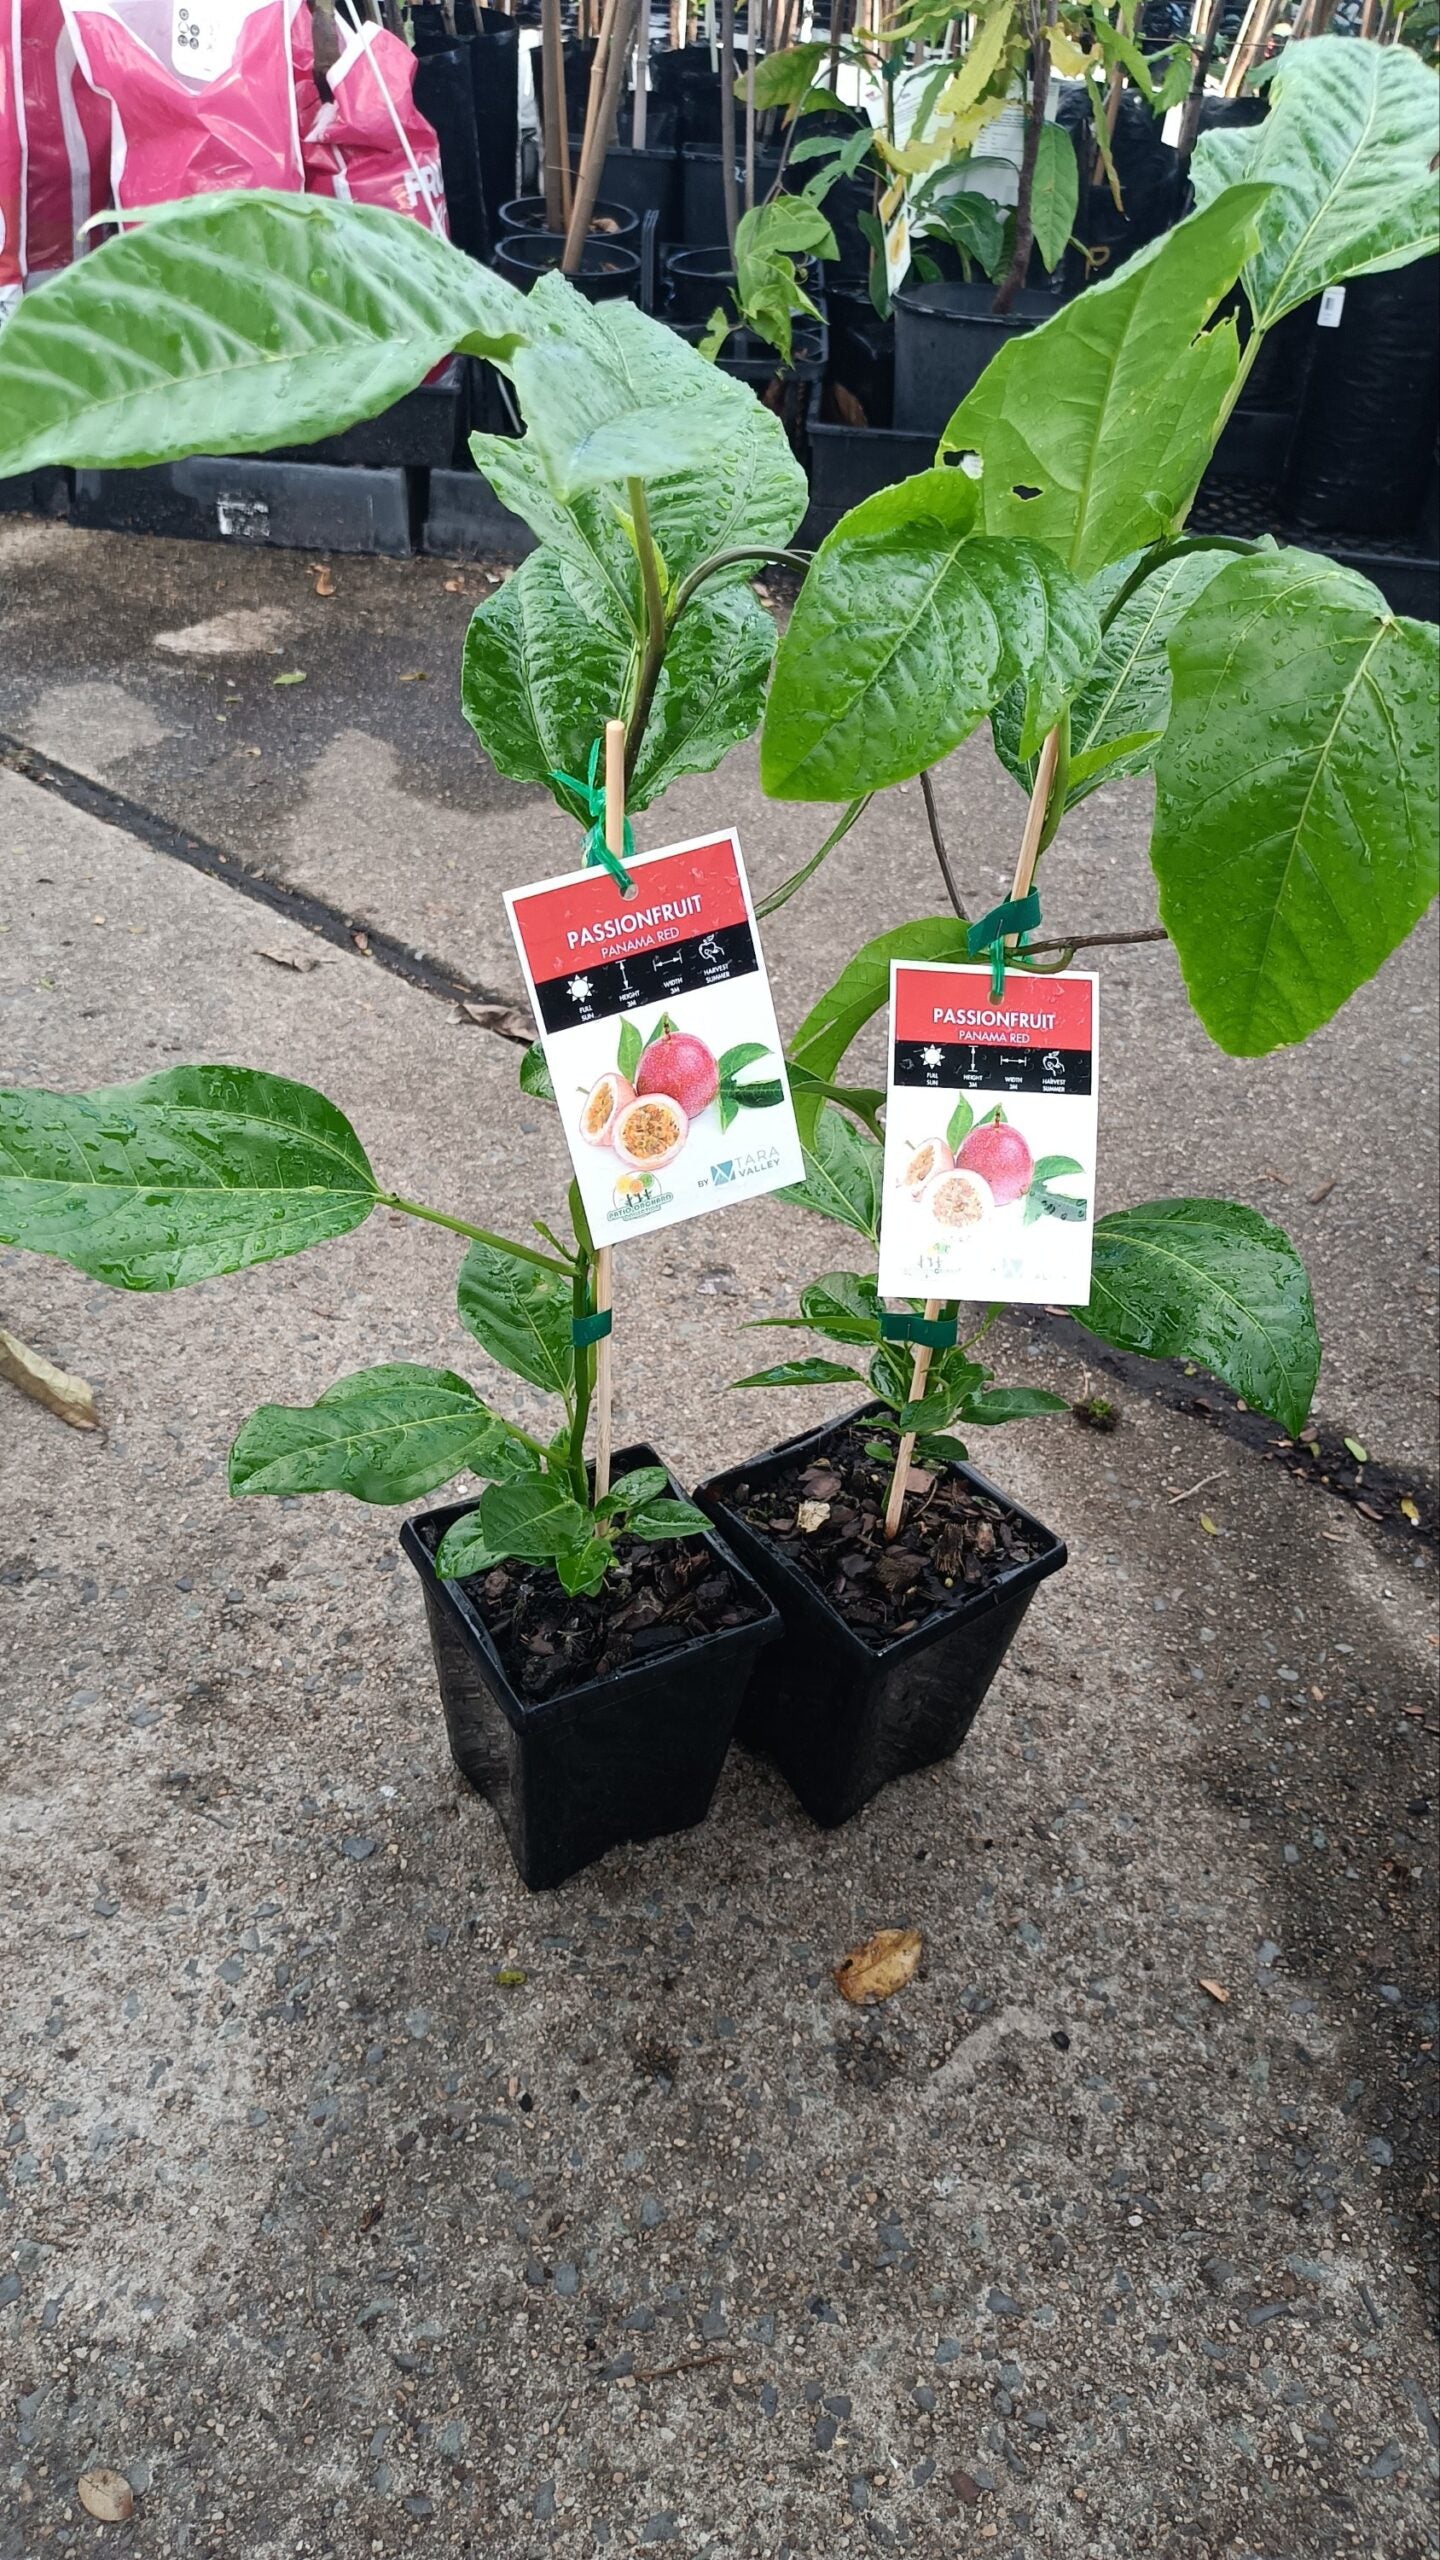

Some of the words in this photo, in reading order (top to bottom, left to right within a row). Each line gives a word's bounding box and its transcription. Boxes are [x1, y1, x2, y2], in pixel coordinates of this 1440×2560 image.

[567, 894, 703, 950] PASSIONFRUIT
[601, 935, 655, 958] PANAMA
[656, 926, 680, 943] RED
[703, 963, 729, 976] HARVEST
[663, 977, 683, 988] WIDTH
[705, 971, 730, 984] SUMMER
[619, 989, 640, 1002] HEIGHT
[670, 986, 680, 995] 3M
[579, 1004, 593, 1014] FULL
[581, 1013, 595, 1022] SUN
[933, 1007, 1056, 1030] PASSIONFRUIT
[958, 1030, 1006, 1043] PANAMA
[1010, 1032, 1030, 1044] RED
[734, 1146, 780, 1169] TARA
[697, 1179, 709, 1188] BY
[738, 1158, 780, 1177] VALLEY
